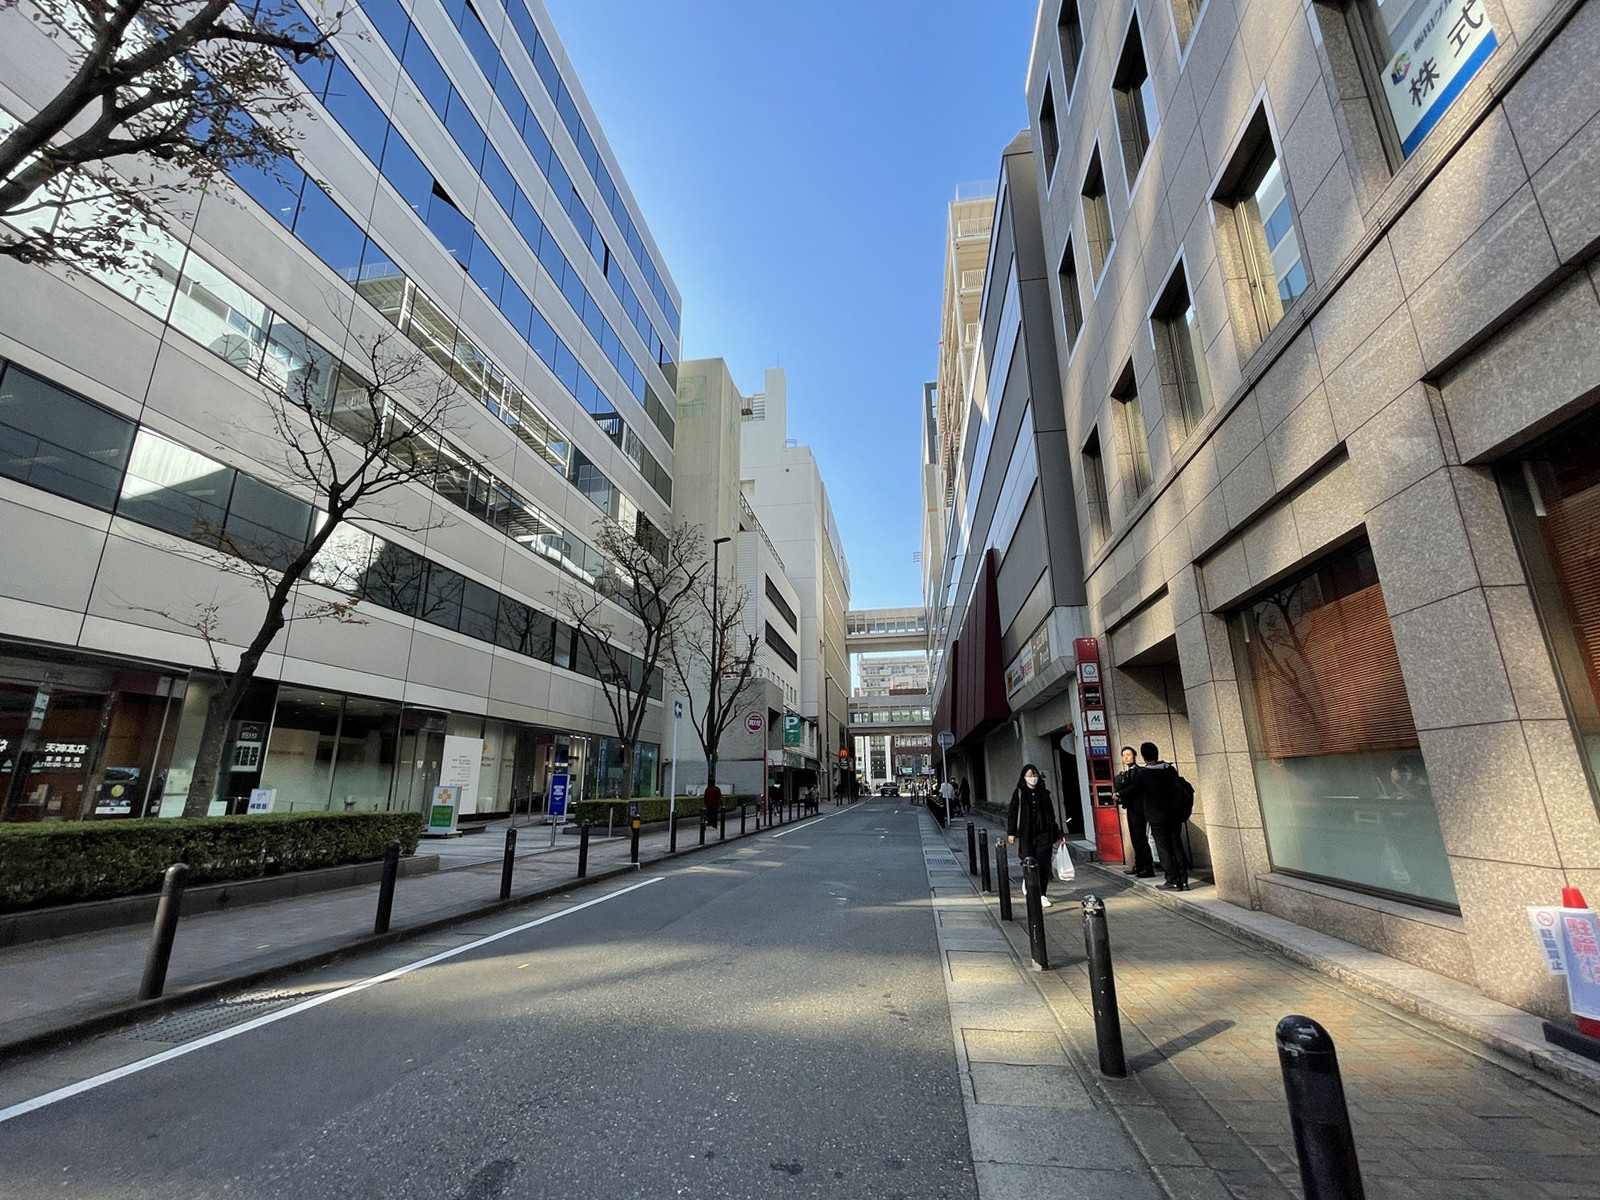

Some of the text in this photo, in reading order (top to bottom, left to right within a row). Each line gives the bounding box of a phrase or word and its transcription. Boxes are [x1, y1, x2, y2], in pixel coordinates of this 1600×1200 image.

[785, 716, 799, 729] P
[45, 742, 87, 754] 天神本店
